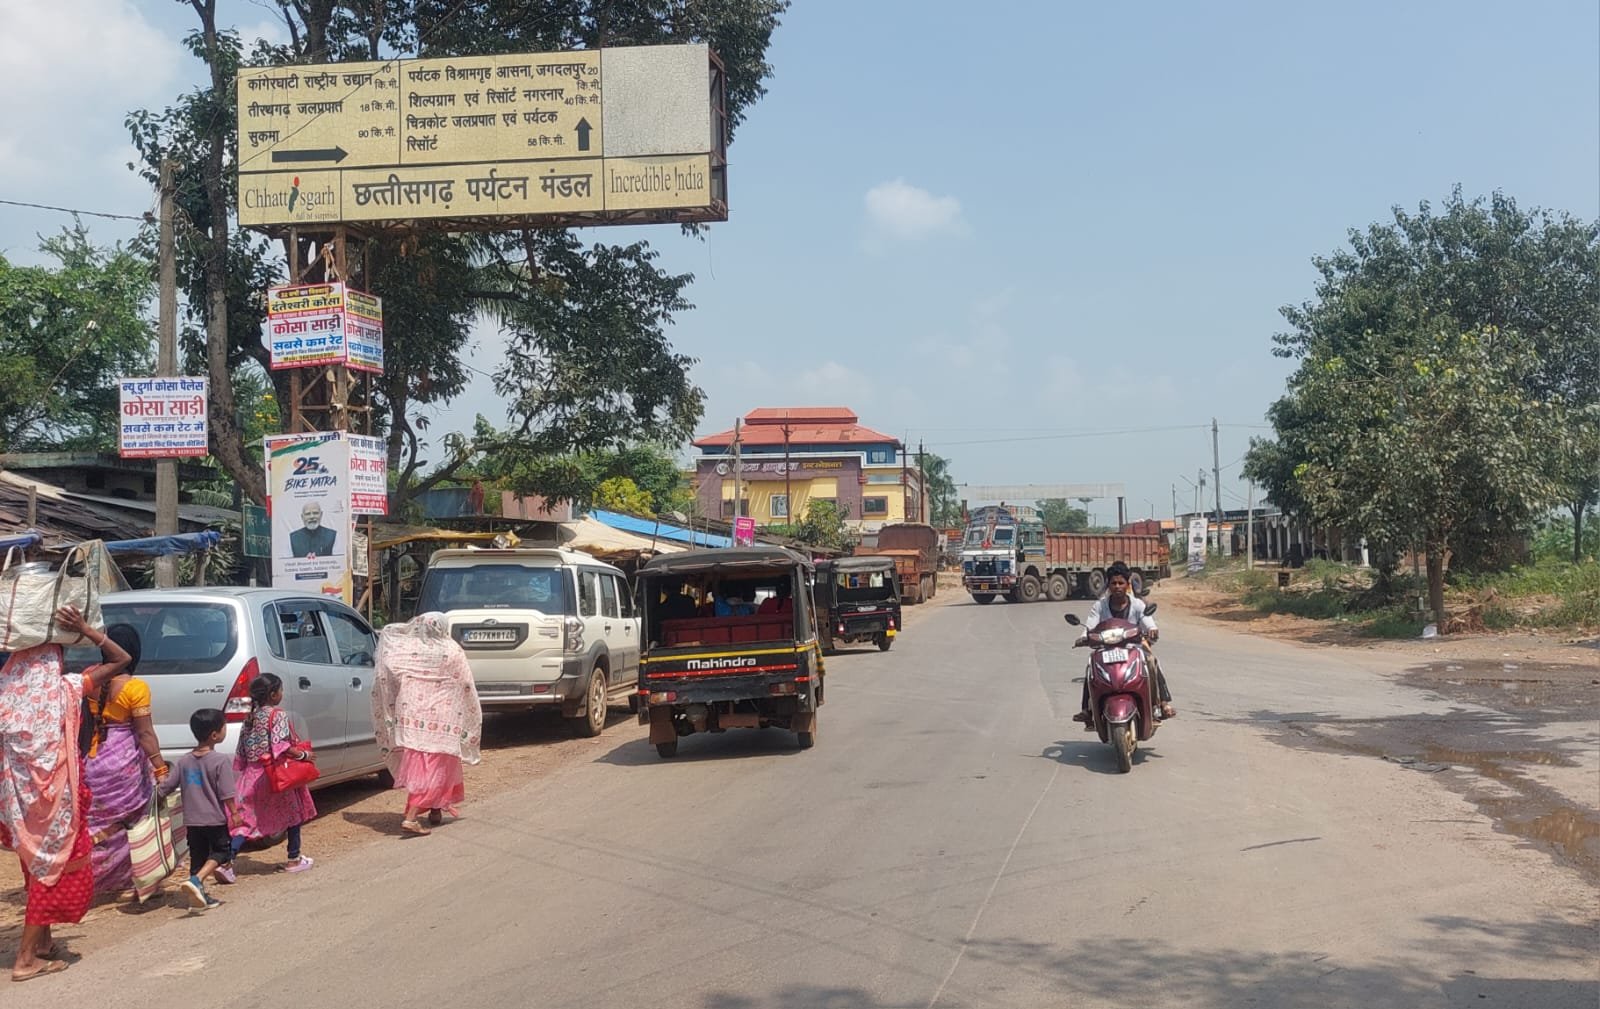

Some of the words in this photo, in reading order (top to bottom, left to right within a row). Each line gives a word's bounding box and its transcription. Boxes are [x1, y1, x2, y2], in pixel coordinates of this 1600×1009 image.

[248, 74, 299, 90] कांगेरघाटी
[304, 72, 337, 90] राष्ट्रीय
[343, 74, 373, 87] उद्यान
[408, 66, 440, 82] पर्यटक
[446, 65, 492, 83] विश्रामगृह
[536, 63, 586, 80] जगदलपुर
[409, 92, 455, 108] शिल्पग्राम
[464, 90, 480, 106] एवं
[487, 87, 516, 104] रिसॉर्ट
[523, 88, 564, 102] नगरनार
[564, 97, 574, 106] 40
[248, 102, 291, 118] तीरथगढ़
[296, 100, 343, 114] जलप्रपात
[406, 113, 447, 130] चित्रकोट
[452, 114, 496, 128] जलप्रपात
[503, 109, 517, 127] एवं
[524, 108, 558, 125] पर्यटक
[248, 130, 280, 147] सुकमा
[406, 135, 438, 152] रिसॉर्ट
[352, 174, 455, 209] छत्तीसगढ़
[466, 168, 529, 201] पर्यटन
[539, 168, 593, 199] मंडल
[610, 167, 671, 194] Incredible
[272, 298, 309, 312] दंतेश्वरी
[312, 296, 340, 307] कोसा
[272, 320, 307, 334] कोसा
[311, 314, 341, 332] साड़ी
[273, 338, 302, 350] सबसे
[305, 338, 326, 347] कम
[329, 335, 342, 346] रेट
[122, 382, 137, 395] न्यू
[137, 380, 152, 394] दुर्गा
[155, 380, 178, 391] कोसा
[180, 379, 203, 391] पैलेस
[123, 396, 164, 416] कोसा
[168, 395, 204, 418] साड़ी
[123, 422, 150, 433] सबसे
[154, 424, 175, 432] कम
[177, 421, 191, 431] रेट
[193, 420, 204, 431] में
[293, 457, 319, 475] 25
[284, 478, 309, 492] BIKE
[310, 476, 336, 489] YATRA
